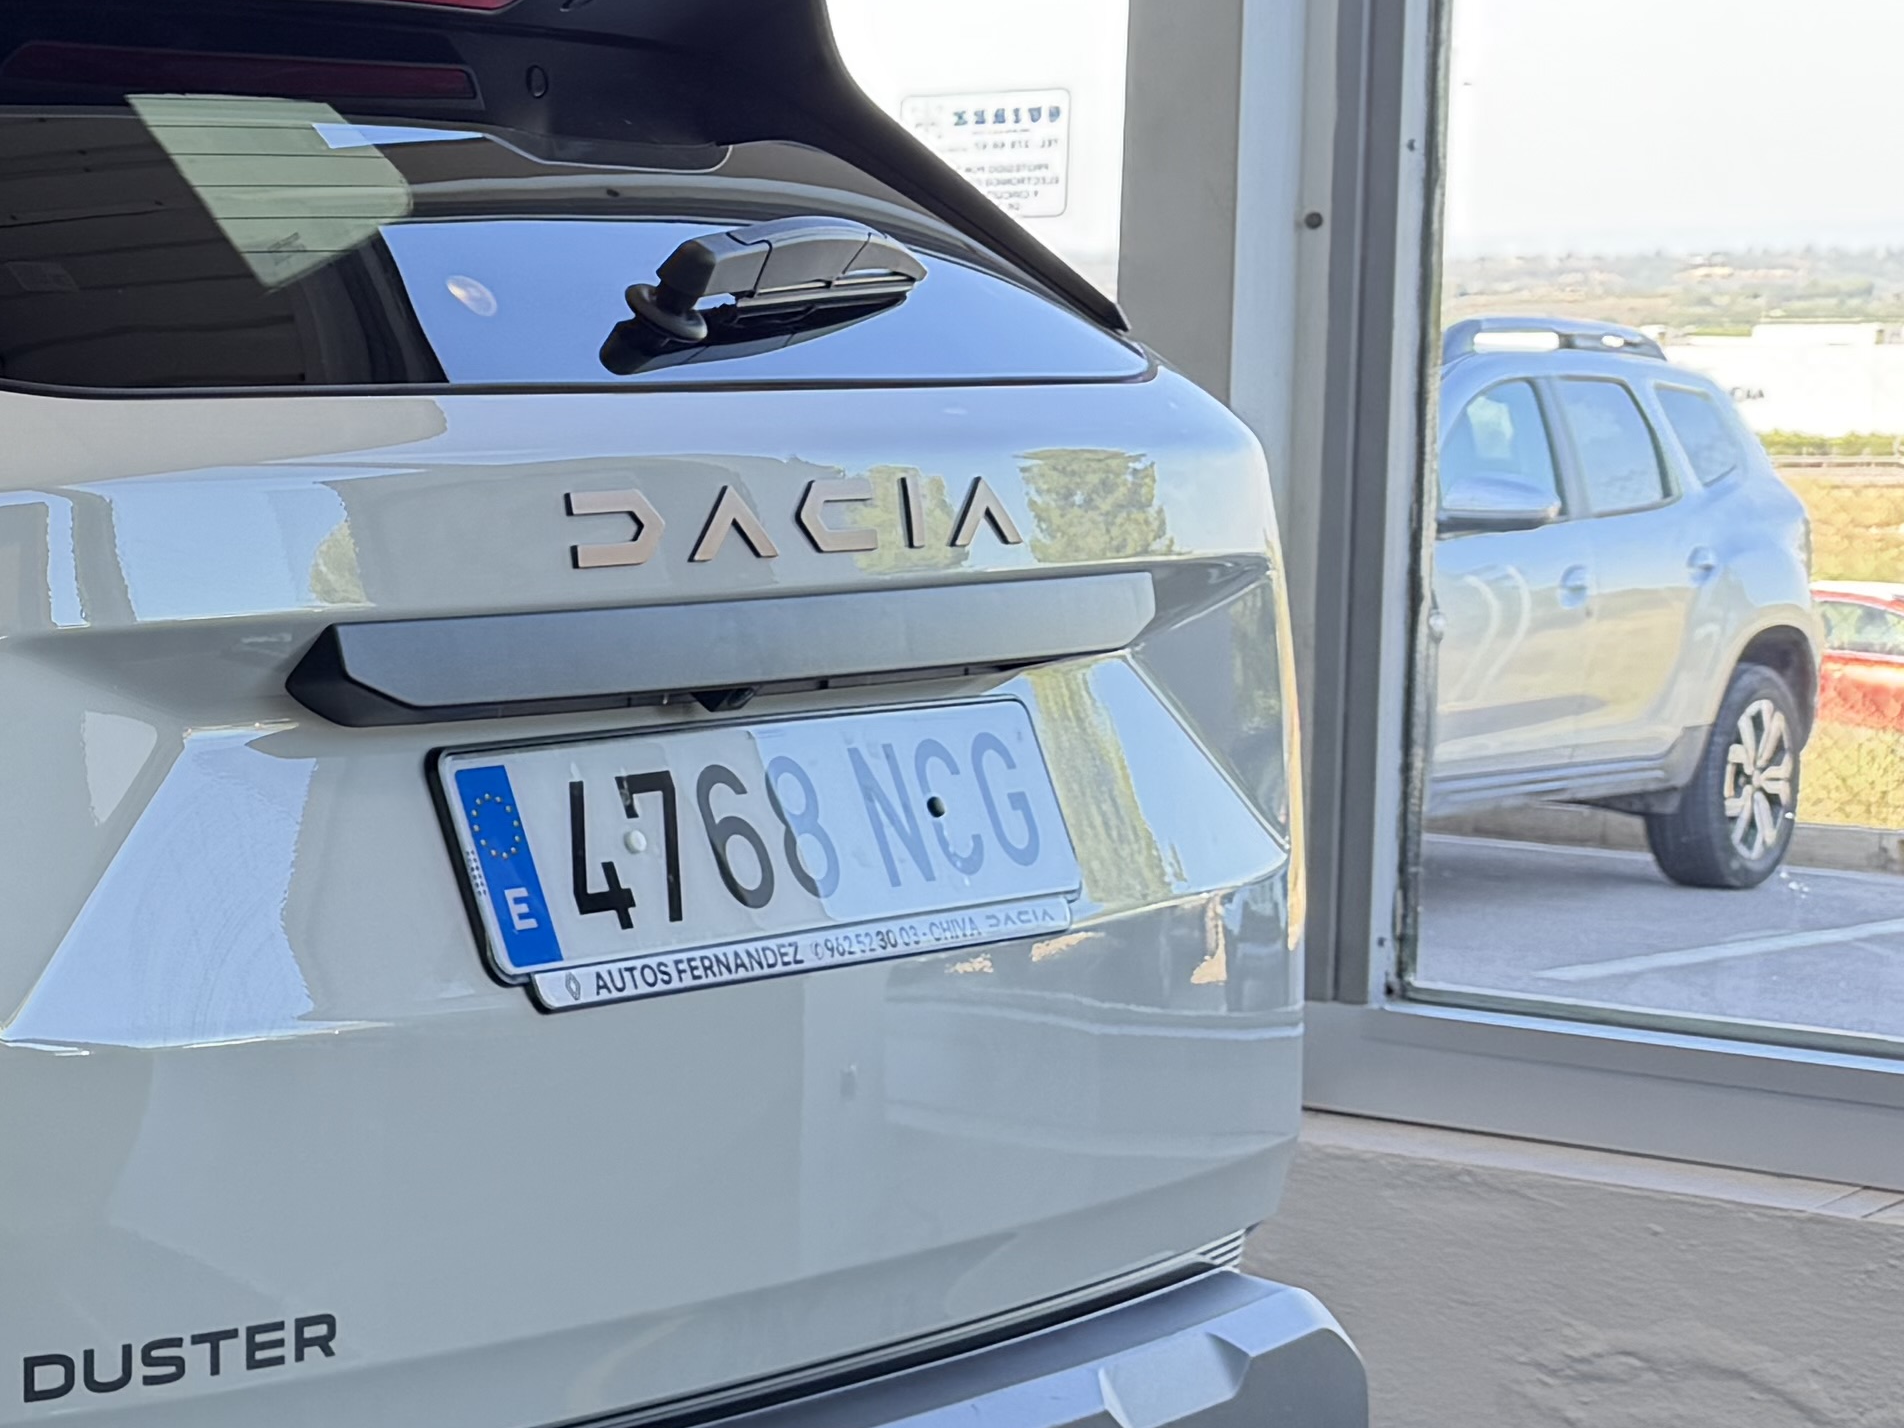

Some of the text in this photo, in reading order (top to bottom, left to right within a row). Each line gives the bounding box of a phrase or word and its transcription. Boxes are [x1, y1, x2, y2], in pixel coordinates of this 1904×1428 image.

[565, 475, 1023, 569] DACIA
[569, 732, 1041, 930] 4768 NCG
[507, 888, 539, 931] E
[595, 961, 673, 996] AUTOS
[674, 942, 804, 983] FERNANDEZ
[988, 908, 1055, 929] DACIA
[23, 1313, 337, 1403] DUSTER
